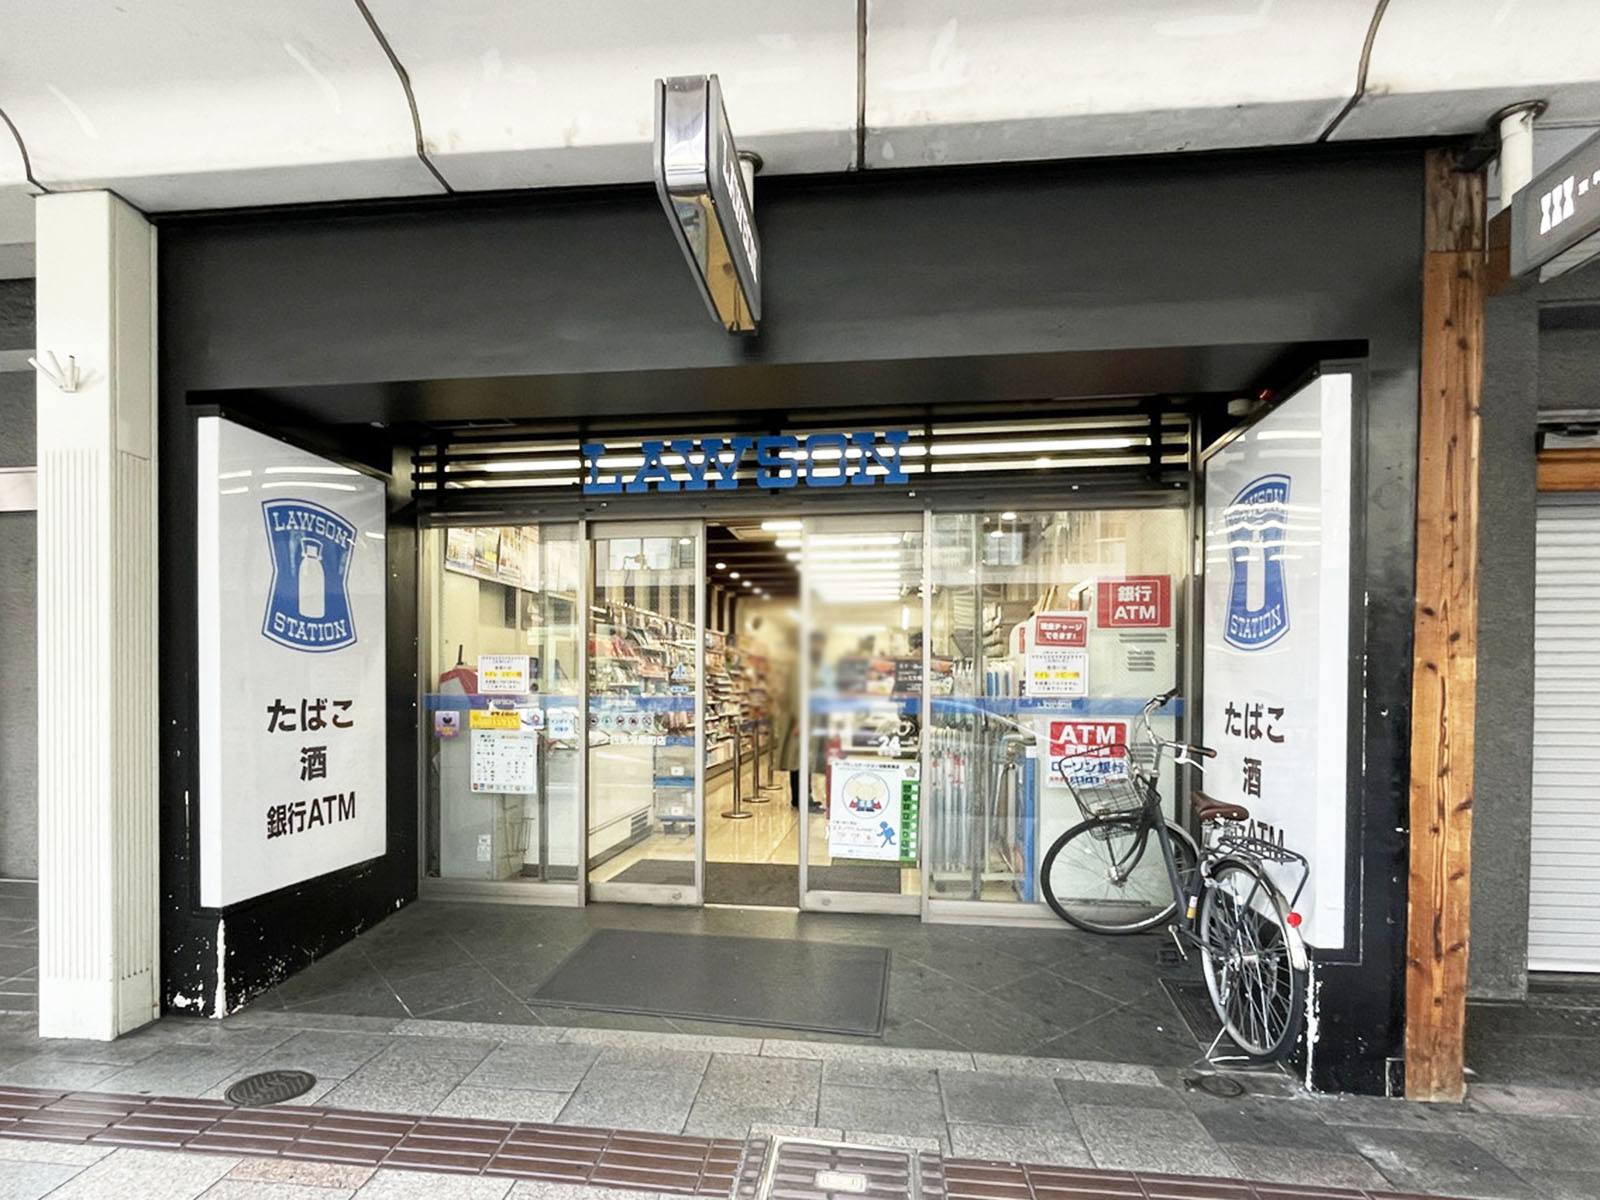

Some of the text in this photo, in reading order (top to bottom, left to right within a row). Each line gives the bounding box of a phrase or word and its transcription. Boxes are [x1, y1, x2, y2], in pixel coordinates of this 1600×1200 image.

[583, 431, 908, 494] LAWSON
[273, 510, 348, 549] LAWSON
[1117, 585, 1152, 602] 銀行
[274, 611, 347, 642] STATION
[1114, 605, 1156, 620] ATM
[1230, 603, 1282, 639] STATION
[267, 698, 353, 733] たばこ
[1225, 701, 1285, 743] たばこ
[1058, 725, 1116, 744] ATM
[300, 745, 327, 781] 酒
[1242, 756, 1262, 799] 酒
[267, 791, 356, 839] 銀行ATM
